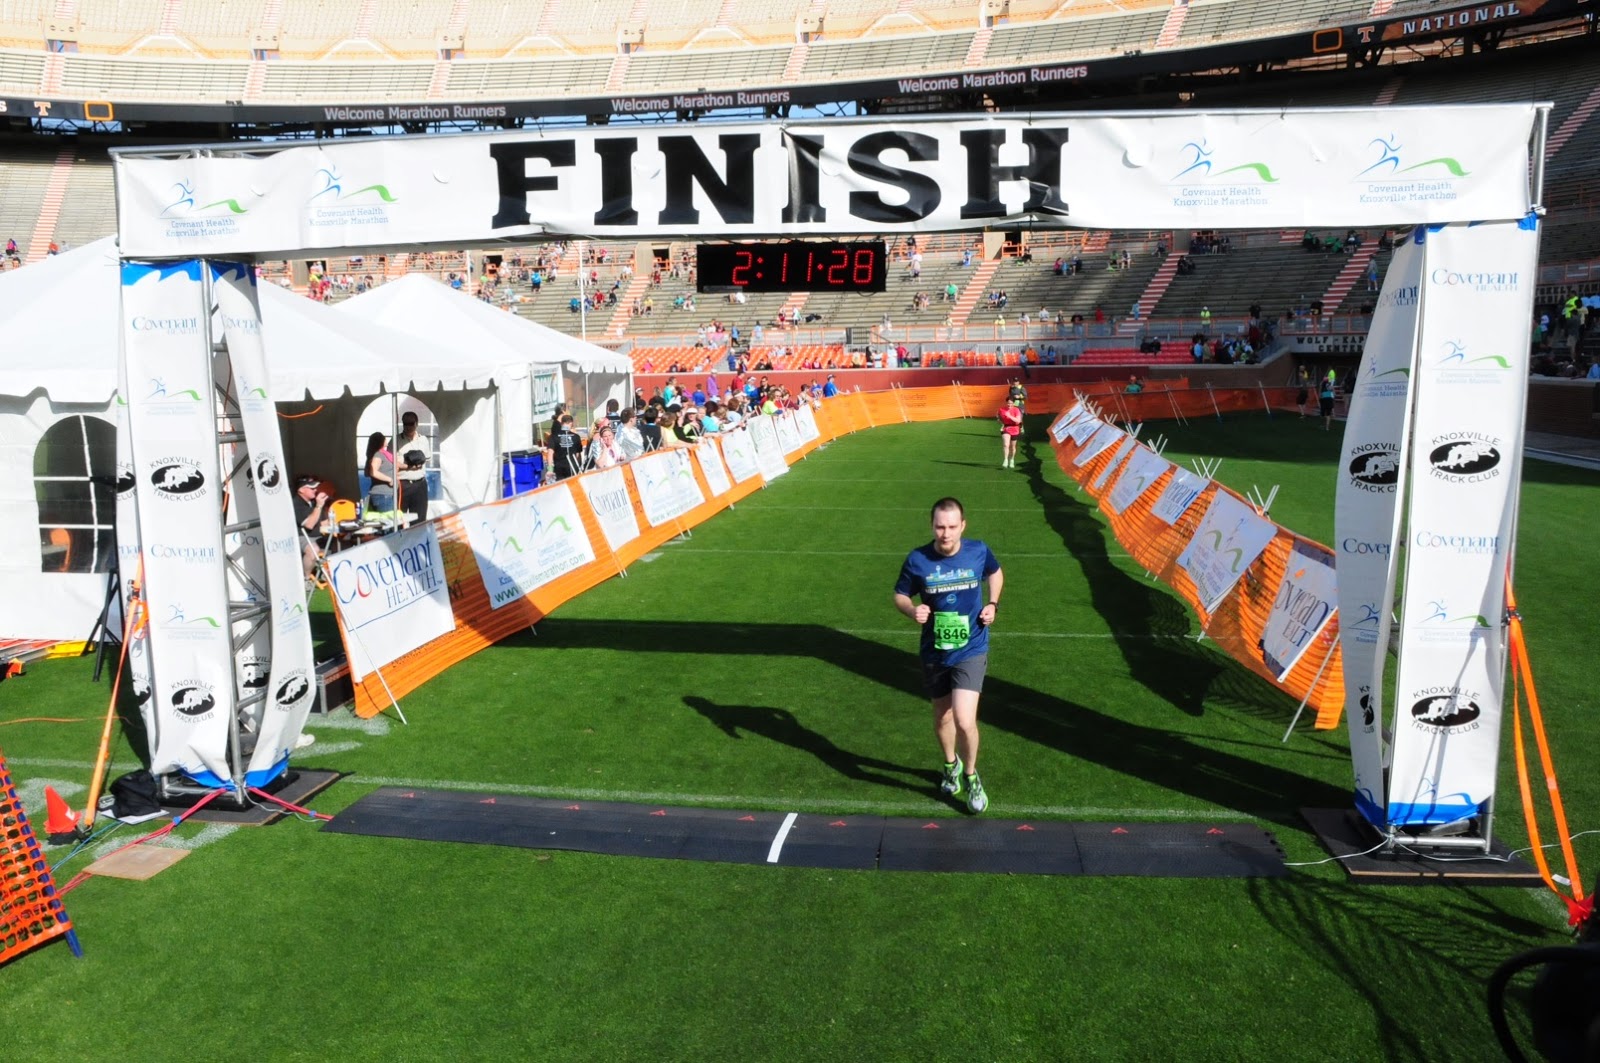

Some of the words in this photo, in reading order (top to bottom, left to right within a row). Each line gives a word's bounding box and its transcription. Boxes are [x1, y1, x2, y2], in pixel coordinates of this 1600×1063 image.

[1403, 4, 1520, 34] NATIONAL
[898, 77, 958, 93] Welcome
[963, 71, 1026, 87] Marathon
[1031, 66, 1087, 81] Runners
[612, 98, 669, 111] Welcome
[674, 94, 733, 108] Marathon
[738, 91, 790, 104] Runners
[325, 107, 384, 120] Welcome
[389, 107, 449, 119] Marathon
[454, 106, 506, 117] Runners
[490, 128, 1069, 229] FINISH
[1182, 188, 1226, 196] Covenant
[1229, 187, 1261, 195] Health
[1368, 184, 1414, 192] Covenant
[1418, 182, 1452, 191] Health
[1173, 198, 1218, 206] Knoxville
[1222, 197, 1268, 205] Marathon
[1360, 194, 1406, 202] Knoxville
[1410, 192, 1456, 200] Marathon
[1432, 269, 1519, 285] Covenant
[132, 317, 197, 331] Covenant
[1296, 336, 1328, 344] WOLF
[1432, 432, 1500, 446] KNOXVILLE
[150, 456, 202, 469] KNOXVILLE
[1429, 467, 1465, 483] TRACK
[1468, 468, 1500, 483] CLUB
[1350, 478, 1385, 493] TRACK
[153, 488, 182, 502] TRACK
[184, 488, 206, 502] CLUB
[1417, 531, 1499, 548] Covenant
[151, 544, 214, 558] Covenant
[334, 536, 432, 604] Covenant
[386, 568, 436, 608] HEALTH
[936, 628, 967, 640] 1846
[171, 680, 216, 692] KNOXVILLE
[1413, 686, 1480, 700] KNOXVILLE
[1411, 720, 1446, 735] TRACK
[1448, 722, 1480, 735] CLUB
